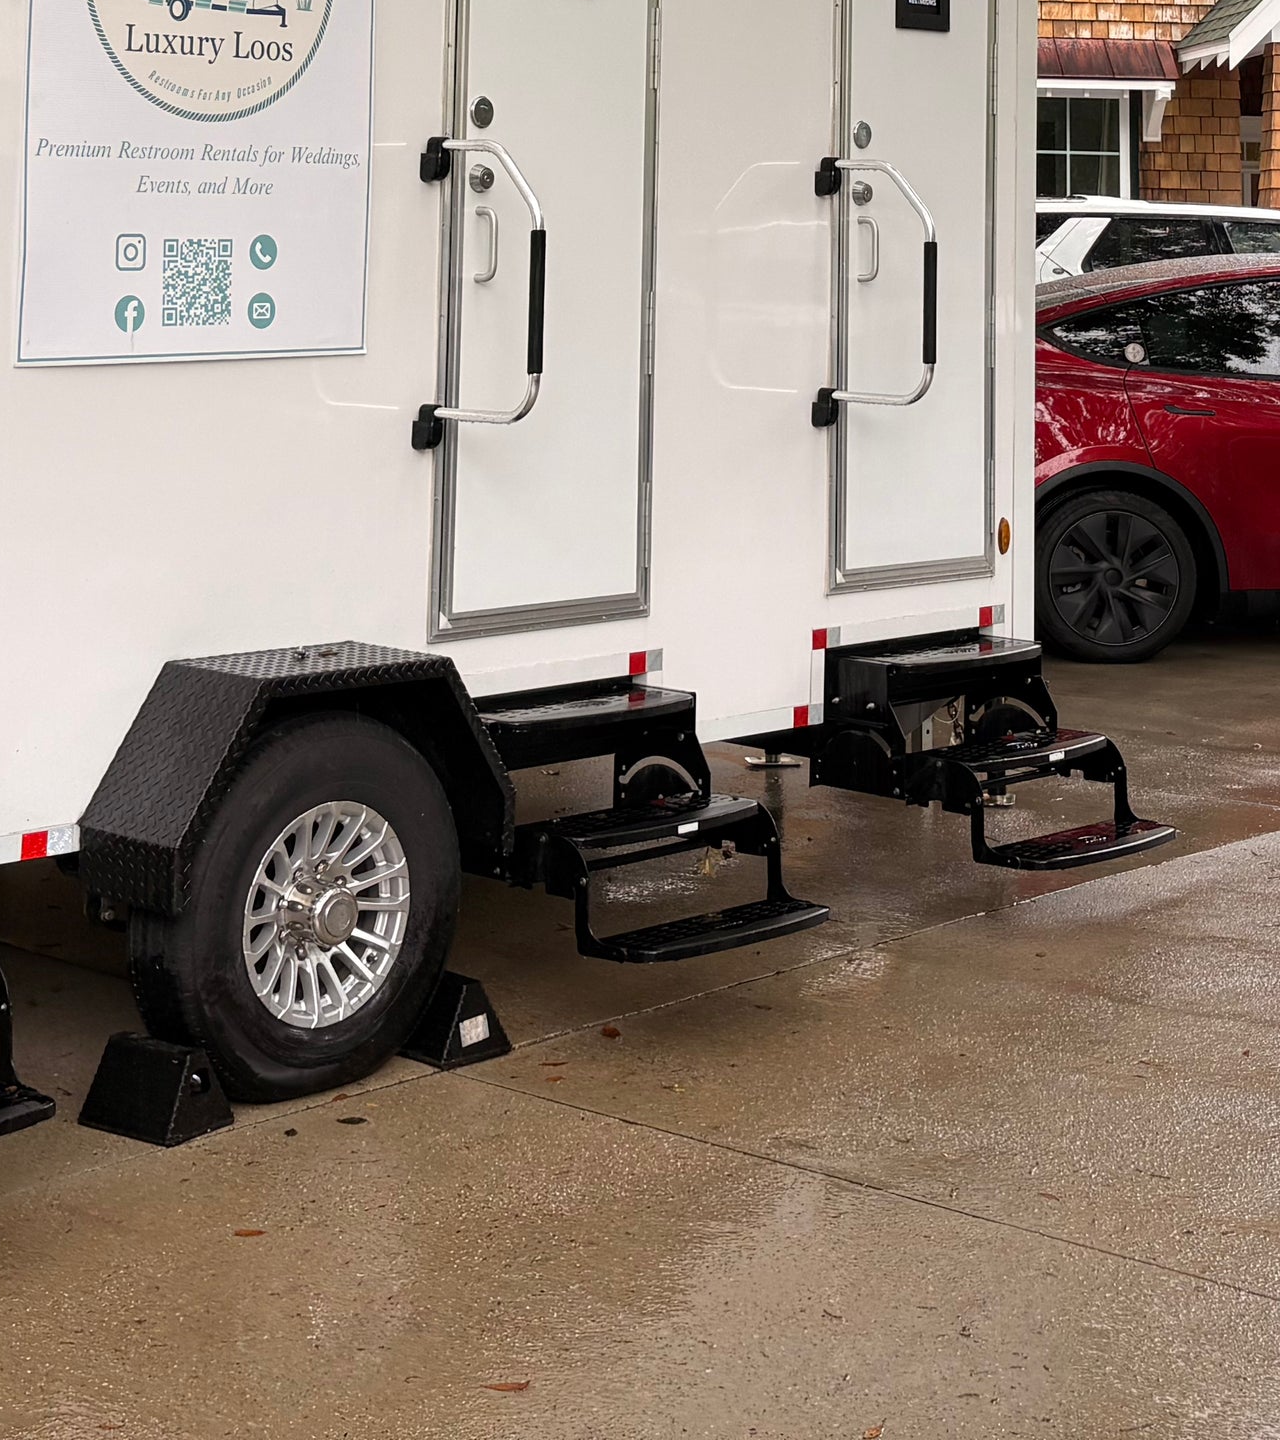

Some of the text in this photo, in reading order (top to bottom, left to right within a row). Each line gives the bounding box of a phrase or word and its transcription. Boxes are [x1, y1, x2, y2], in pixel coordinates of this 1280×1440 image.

[124, 23, 293, 64] Luxury Loos
[148, 70, 273, 103] Restrooms For Any Occasion
[35, 138, 361, 170] Premium Restroom Rentals for Weddings,
[136, 175, 274, 196] Events, and More
